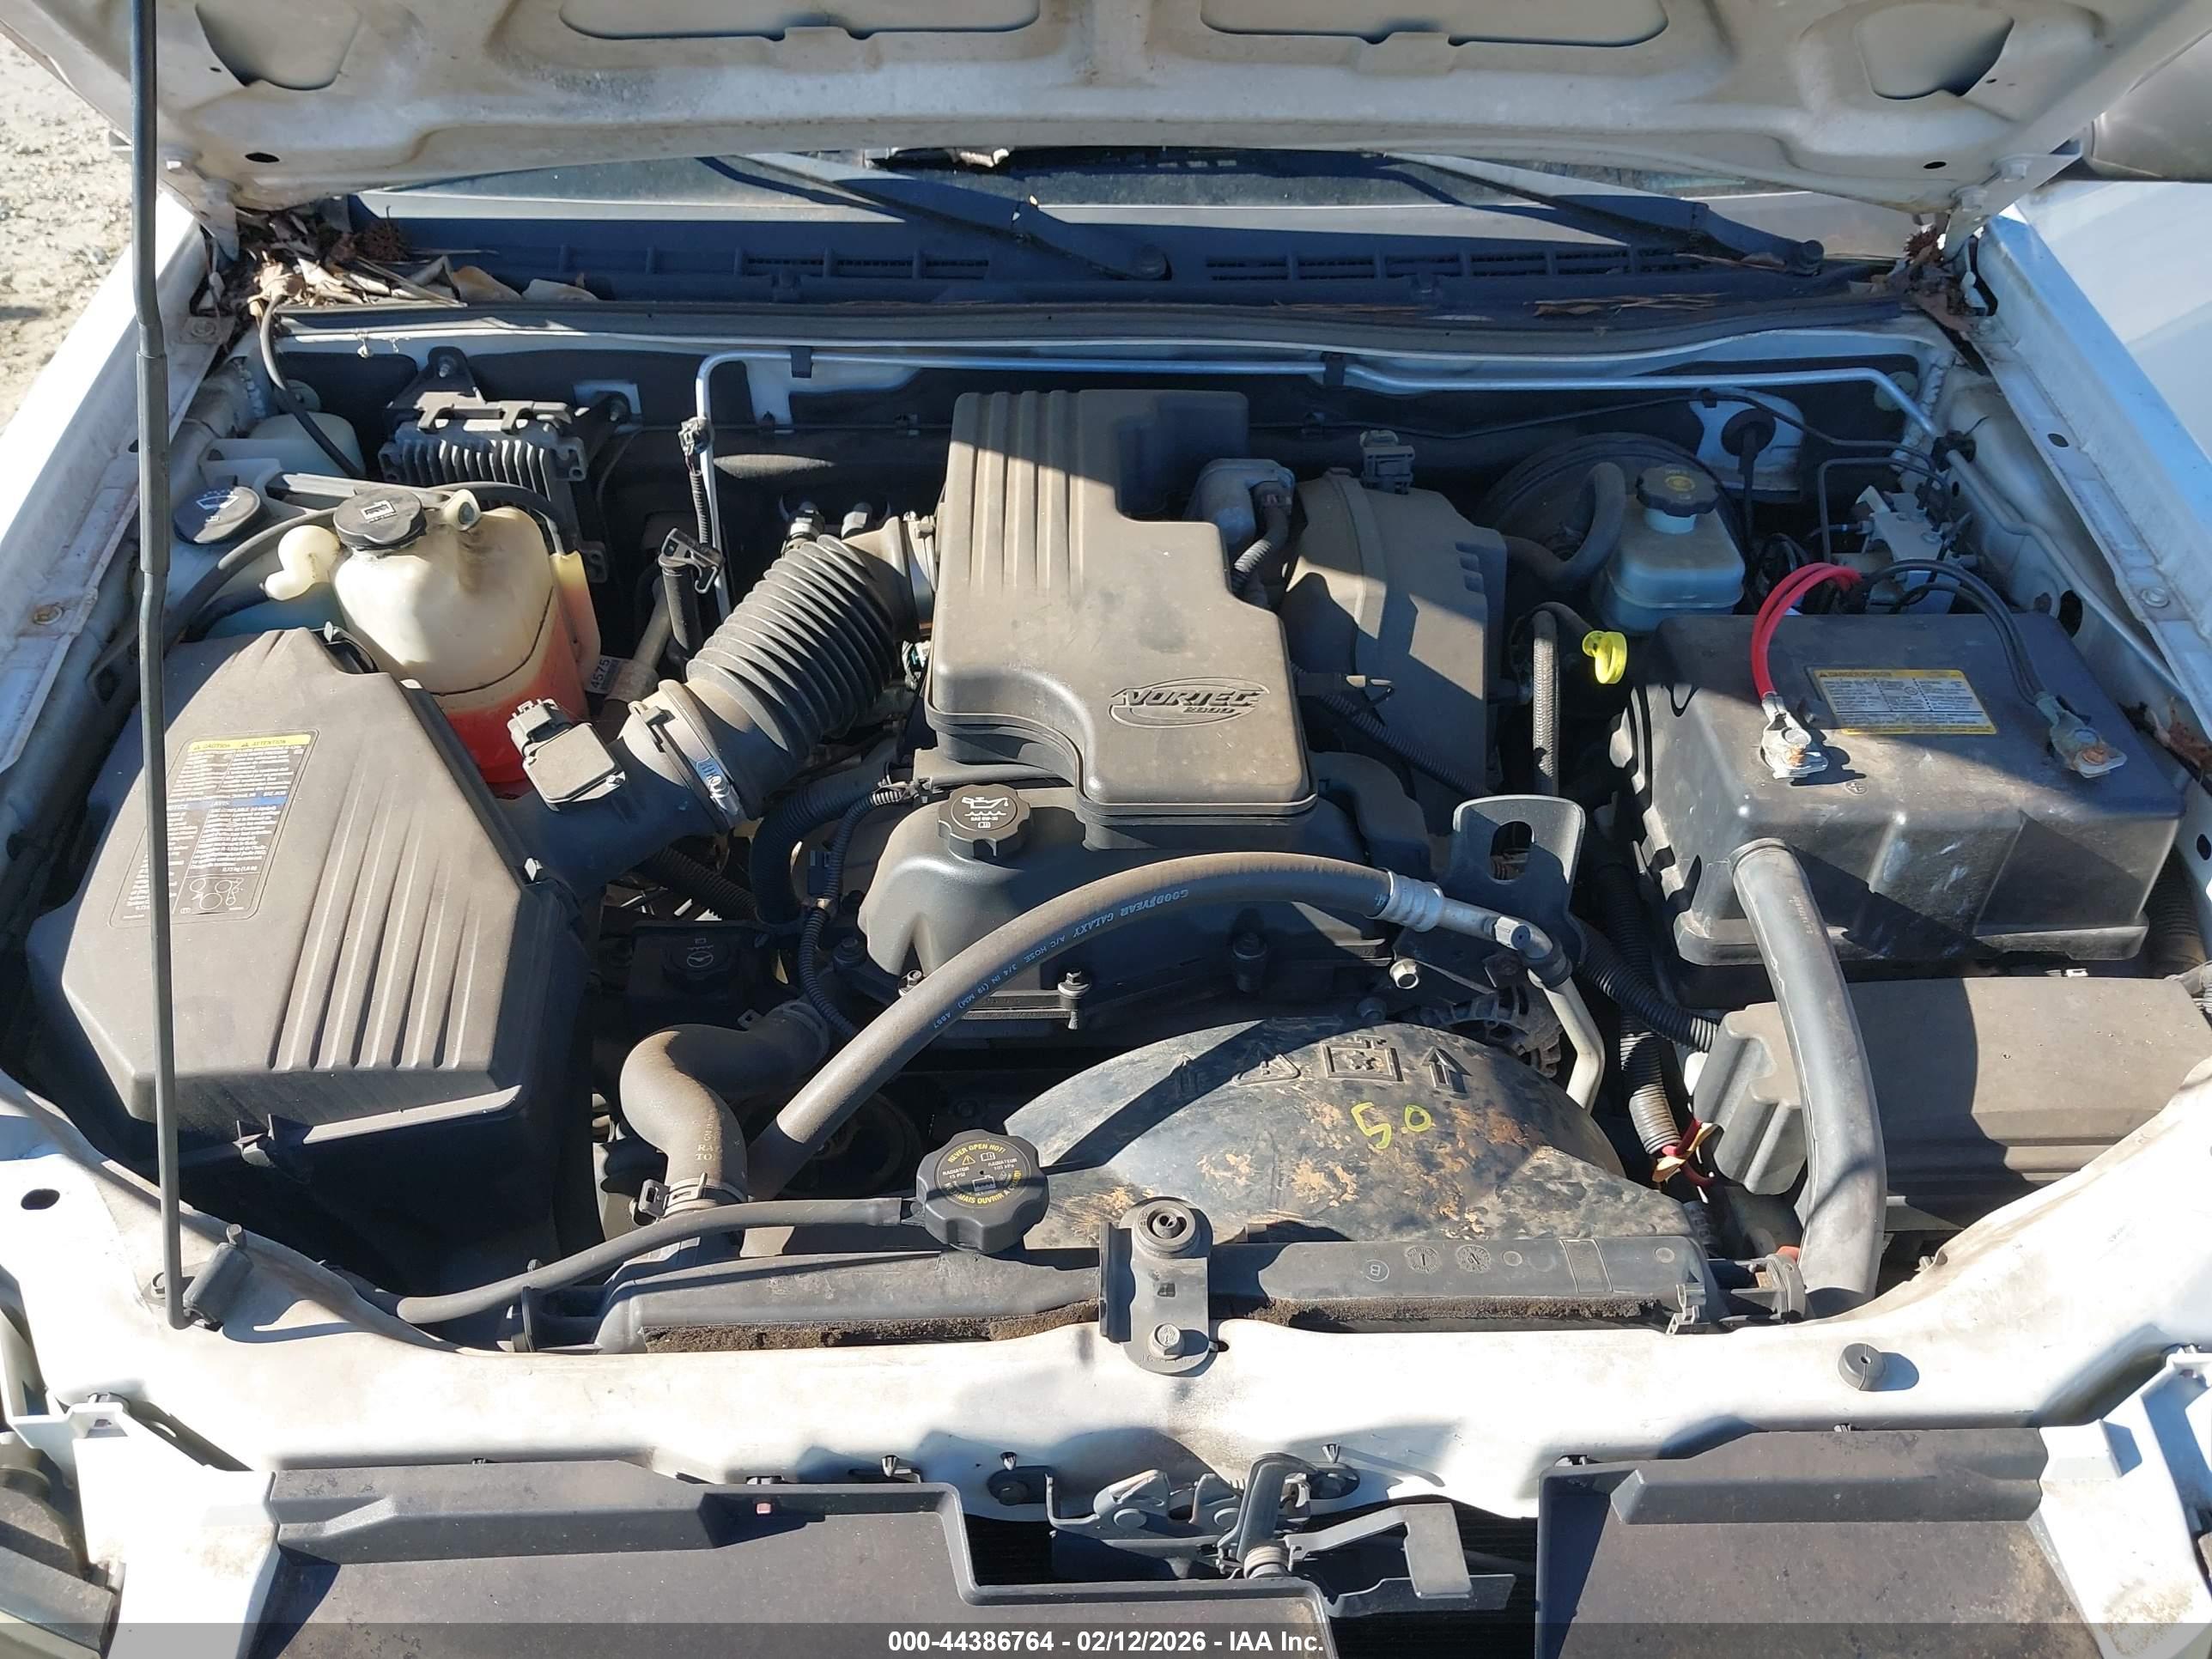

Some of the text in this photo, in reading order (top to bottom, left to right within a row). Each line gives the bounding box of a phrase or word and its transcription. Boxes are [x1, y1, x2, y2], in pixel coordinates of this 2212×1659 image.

[1125, 690, 1261, 707] VORTEC
[1120, 889, 1189, 917] GOODYEAR
[1073, 912, 1114, 938] GALAXY
[1050, 935, 1066, 948] A/C
[1024, 946, 1048, 963] HOSE
[1003, 963, 1018, 975] 3/4
[991, 975, 1000, 984] IN
[947, 1147, 969, 1164] NEVER
[988, 1144, 1007, 1154] HOT!
[943, 1167, 969, 1176] RADIATOR
[977, 1192, 1005, 1204] OUVRIR
